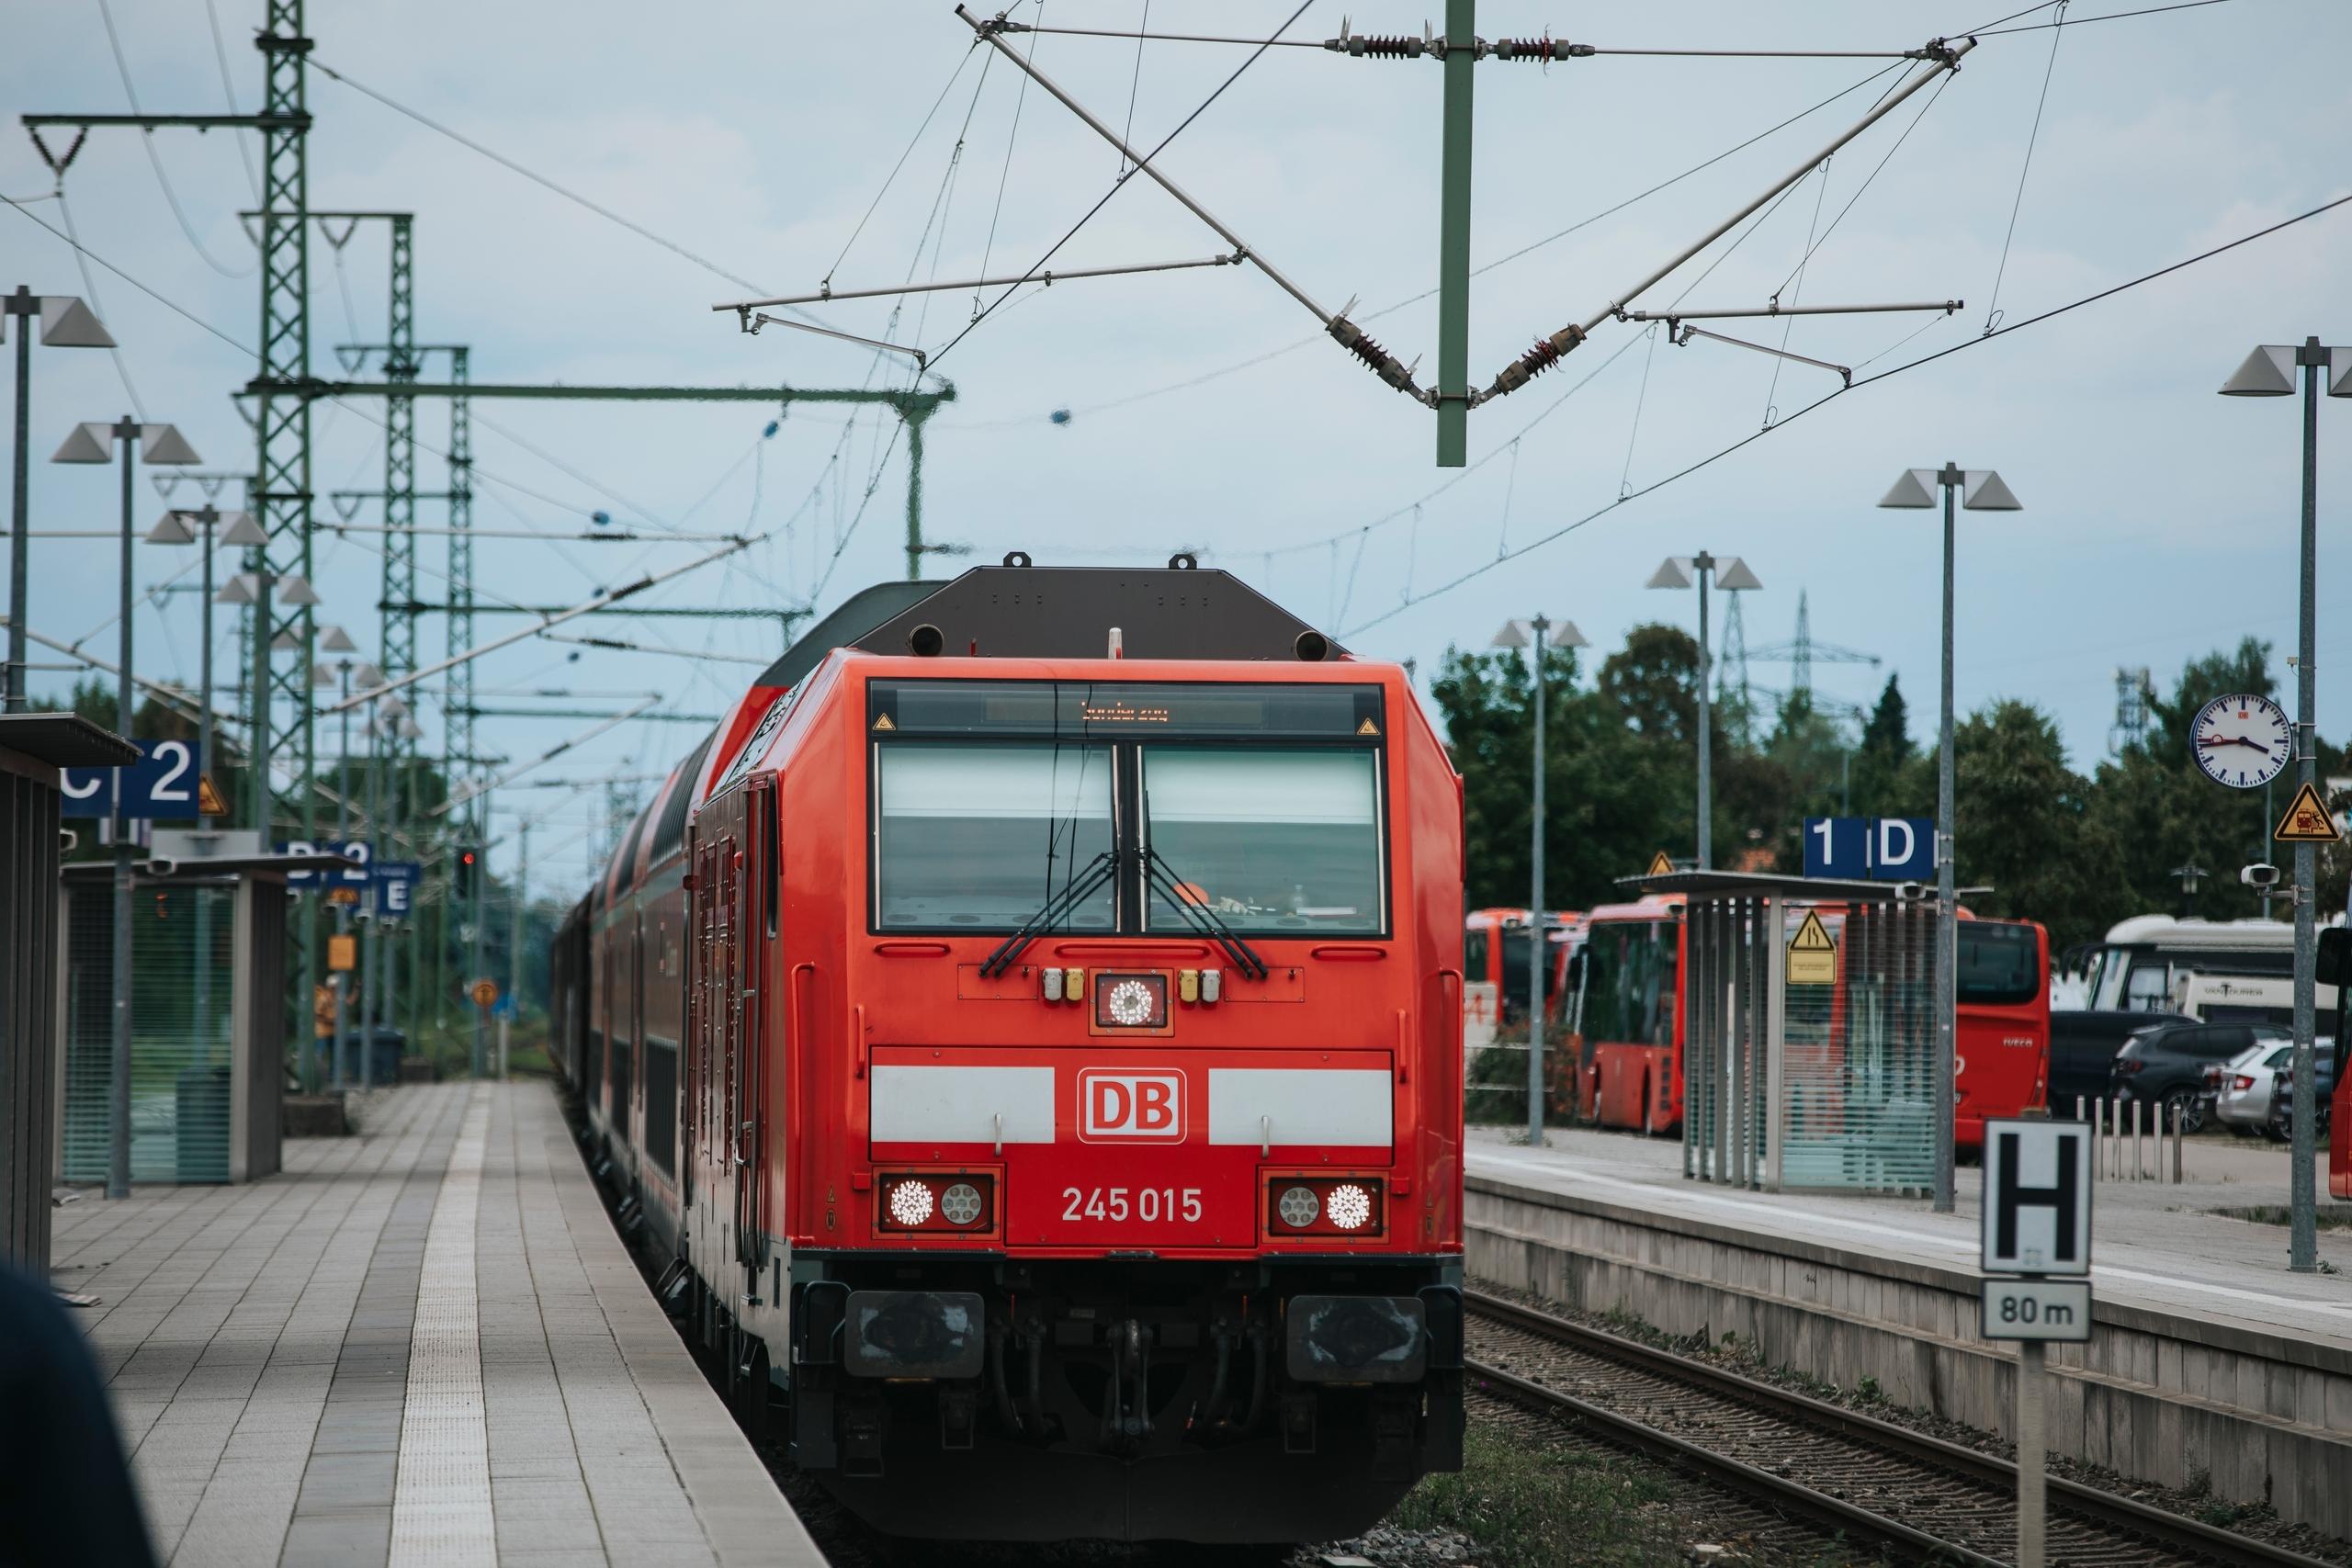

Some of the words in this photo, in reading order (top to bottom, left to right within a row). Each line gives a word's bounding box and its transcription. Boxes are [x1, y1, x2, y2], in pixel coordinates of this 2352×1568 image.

[150, 740, 191, 801] 2
[343, 841, 370, 880] 2
[1813, 818, 1833, 866] 1
[1881, 818, 1917, 866] D
[388, 880, 409, 910] E
[1092, 1081, 1174, 1130] DB
[1062, 1187, 1129, 1223] 245
[1139, 1189, 1202, 1224] 015
[1996, 1132, 2079, 1262] H
[2001, 1296, 2038, 1325] 80
[2045, 1303, 2073, 1325] m
